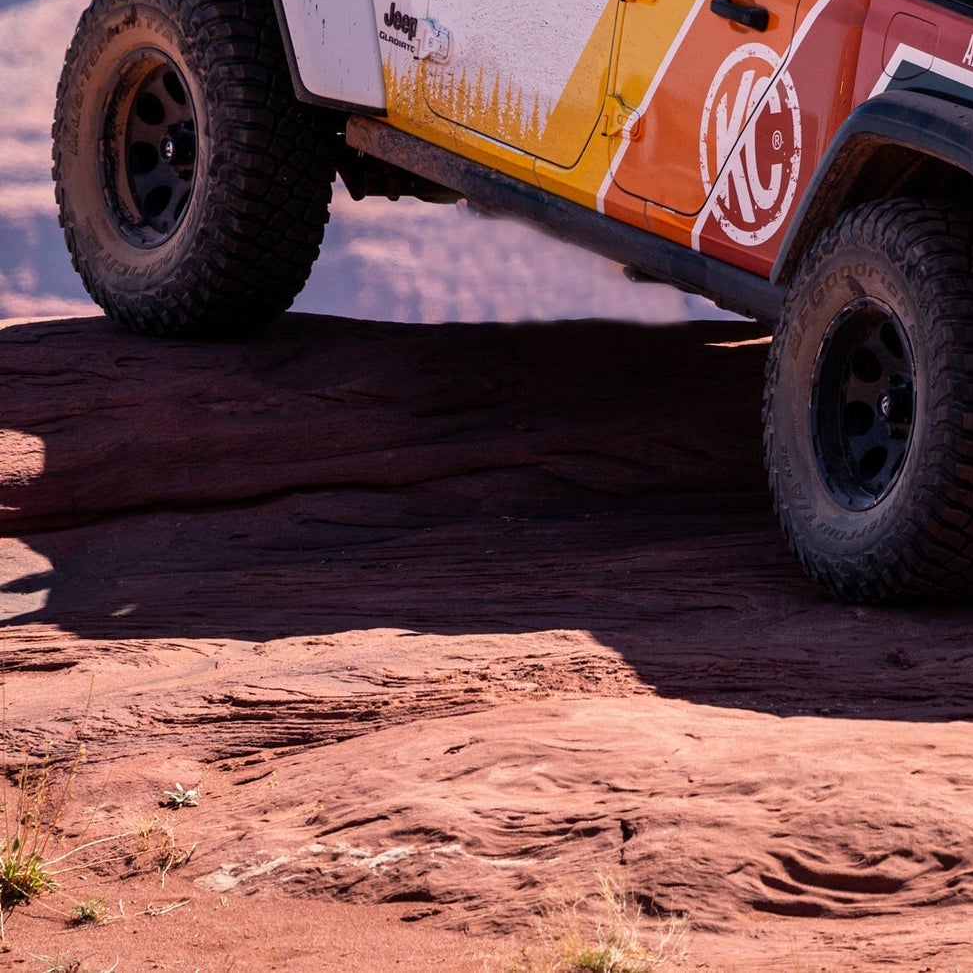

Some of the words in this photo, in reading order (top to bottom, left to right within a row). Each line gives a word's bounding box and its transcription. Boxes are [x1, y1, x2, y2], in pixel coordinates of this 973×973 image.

[384, 2, 418, 41] Jeep
[379, 30, 416, 53] GLADIATO
[715, 69, 783, 224] KC
